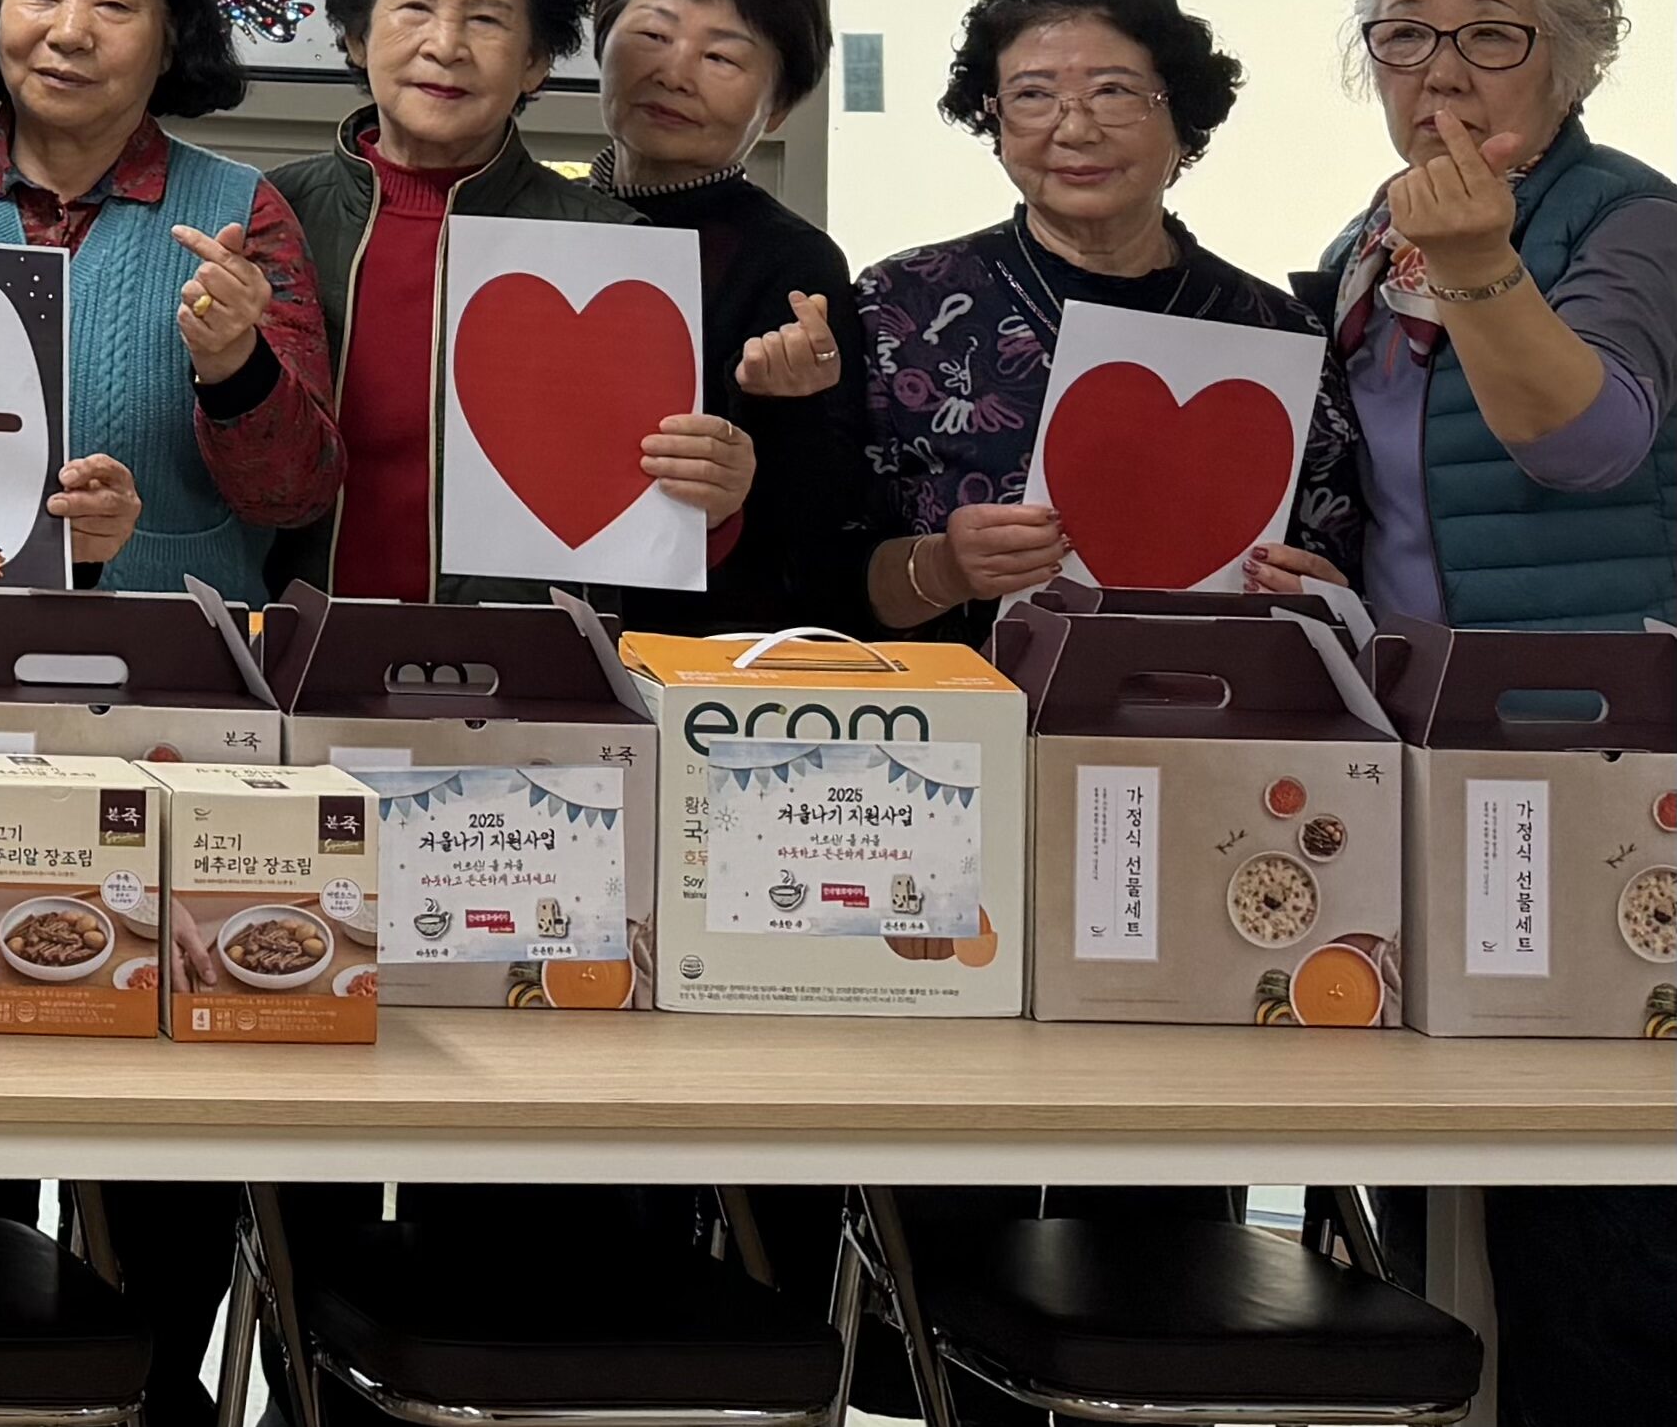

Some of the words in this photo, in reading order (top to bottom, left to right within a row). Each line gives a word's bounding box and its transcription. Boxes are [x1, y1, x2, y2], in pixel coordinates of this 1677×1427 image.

[684, 701, 930, 756] erom
[224, 731, 261, 752] 본죽
[599, 746, 637, 767] 본죽
[1347, 764, 1384, 784] 본죽
[828, 787, 862, 802] 2025
[106, 807, 141, 826] 본죽
[325, 816, 360, 834] 본죽
[469, 814, 504, 828] 2025
[778, 804, 842, 825] 겨울나기
[848, 805, 912, 827] 지원사업
[1126, 786, 1143, 848] 가정식
[419, 831, 483, 852] 겨울나기
[490, 828, 554, 851] 지원사업
[1517, 800, 1534, 863] 가정식
[194, 833, 241, 851] 쇠고기
[44, 849, 92, 867] 장조림
[195, 856, 258, 874] 메추리알
[263, 857, 311, 875] 장조림
[683, 876, 705, 889] Soy
[1125, 856, 1142, 936] 선물세트
[1516, 871, 1534, 952] 선물세트
